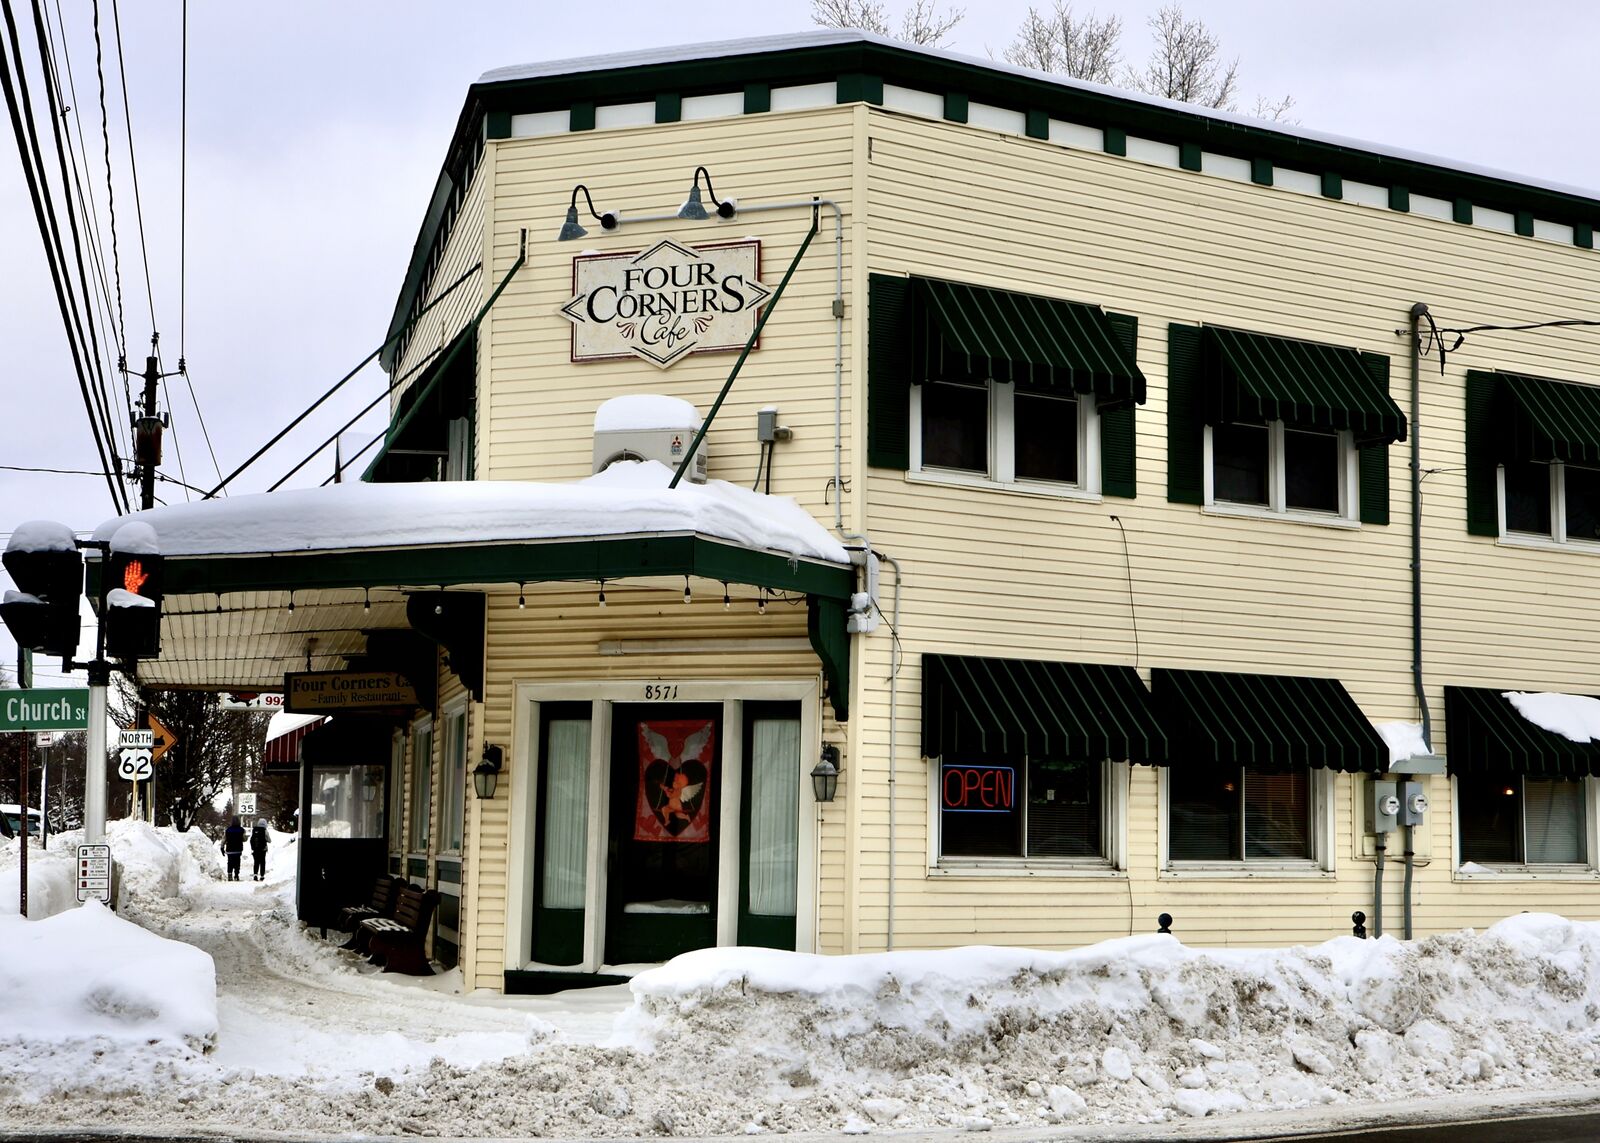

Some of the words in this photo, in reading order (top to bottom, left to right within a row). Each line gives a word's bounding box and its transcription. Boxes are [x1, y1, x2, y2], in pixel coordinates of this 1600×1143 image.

[623, 262, 719, 291] FOUR
[586, 275, 745, 324] CORNERS
[640, 309, 690, 349] Cafe
[293, 678, 327, 692] Four
[332, 676, 390, 690] Corners
[645, 685, 678, 700] 8571
[7, 697, 71, 722] Church
[75, 707, 86, 721] St
[121, 733, 152, 744] NORTH
[122, 756, 149, 775] 62
[943, 769, 1011, 807] OPEN
[240, 804, 254, 813] 35
